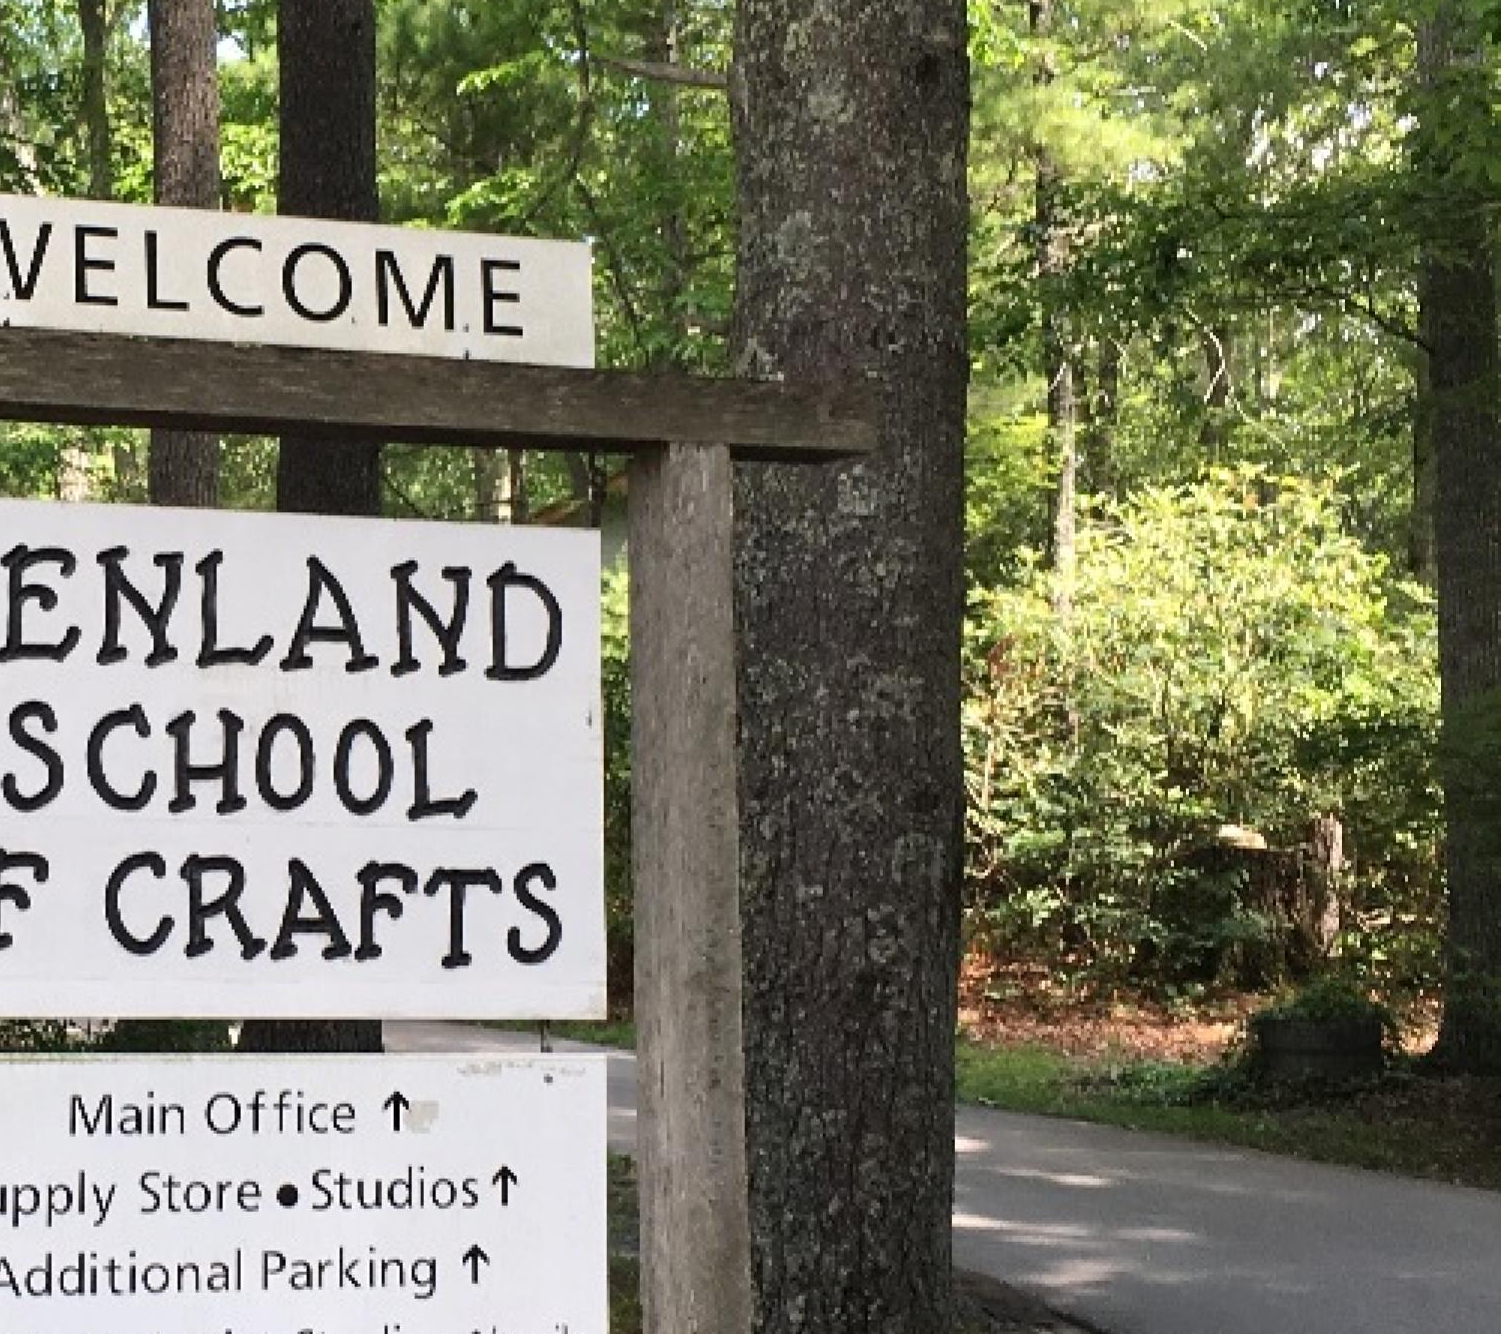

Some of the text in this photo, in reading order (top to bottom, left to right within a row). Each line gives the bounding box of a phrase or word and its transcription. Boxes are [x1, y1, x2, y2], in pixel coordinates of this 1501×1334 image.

[0, 700, 479, 822] SCHOOL
[104, 850, 563, 970] CRAFTS
[69, 1090, 356, 1135] Main Office
[140, 1172, 262, 1213] Store
[312, 1165, 479, 1210] Studios
[263, 1247, 437, 1300] Parking
